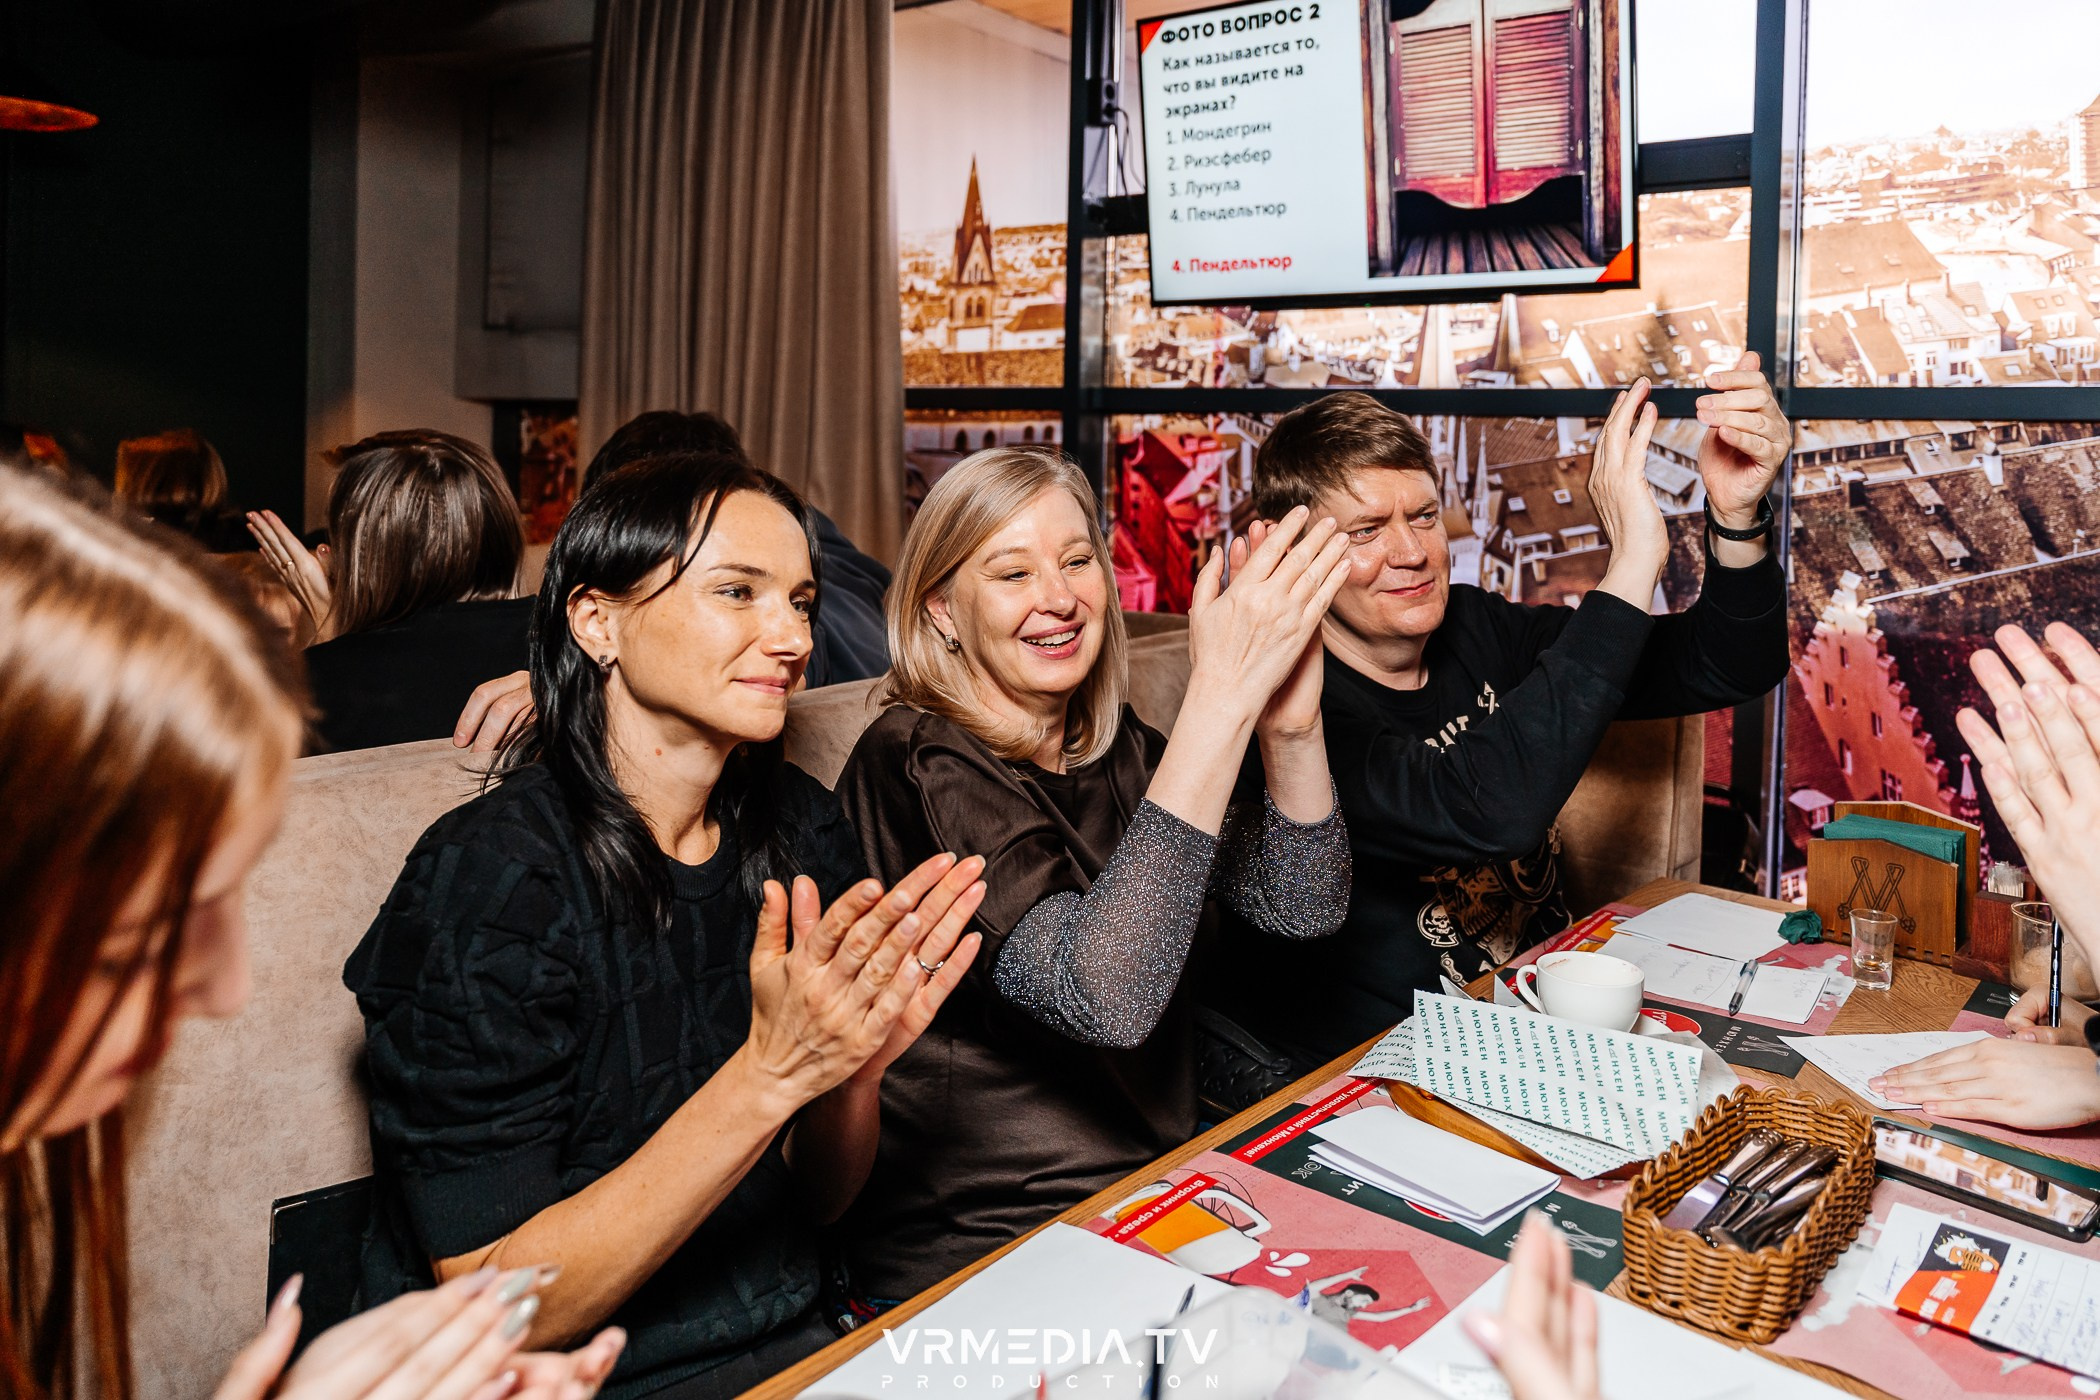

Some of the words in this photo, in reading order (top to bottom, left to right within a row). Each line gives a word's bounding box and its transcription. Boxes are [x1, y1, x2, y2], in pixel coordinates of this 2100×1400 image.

[1161, 22, 1215, 44] ФОТО
[1221, 7, 1302, 34] ВОПРОС
[1309, 4, 1320, 19] 2
[1162, 56, 1191, 71] Как
[1195, 42, 1290, 65] называется
[1296, 38, 1320, 50] то,
[1163, 82, 1190, 94] что
[1195, 78, 1216, 90] вы
[1221, 68, 1279, 86] видите
[1284, 64, 1304, 77] на
[1166, 95, 1236, 119] экранах?
[1167, 131, 1178, 145] 1.
[1181, 122, 1272, 142] Мондегрин
[1168, 157, 1180, 171] 2.
[1184, 148, 1272, 168] Риэсфебер
[1169, 183, 1181, 197] 3.
[1185, 180, 1241, 198] Лунула
[1170, 209, 1183, 222] 4.
[1187, 203, 1287, 222] Пендельтюр
[1172, 260, 1185, 273] 4.
[1189, 256, 1292, 273] Пендельтюр
[1471, 1009, 1488, 1061] МЮНХЕН
[1547, 1024, 1566, 1078] МЮНХЕН
[1626, 1042, 1645, 1097] МЮНХЕН
[1293, 1092, 1349, 1129] удовольствий
[1244, 1129, 1291, 1158] Мюнхене!
[1159, 1179, 1206, 1209] Вторник
[1118, 1211, 1154, 1235] среда
